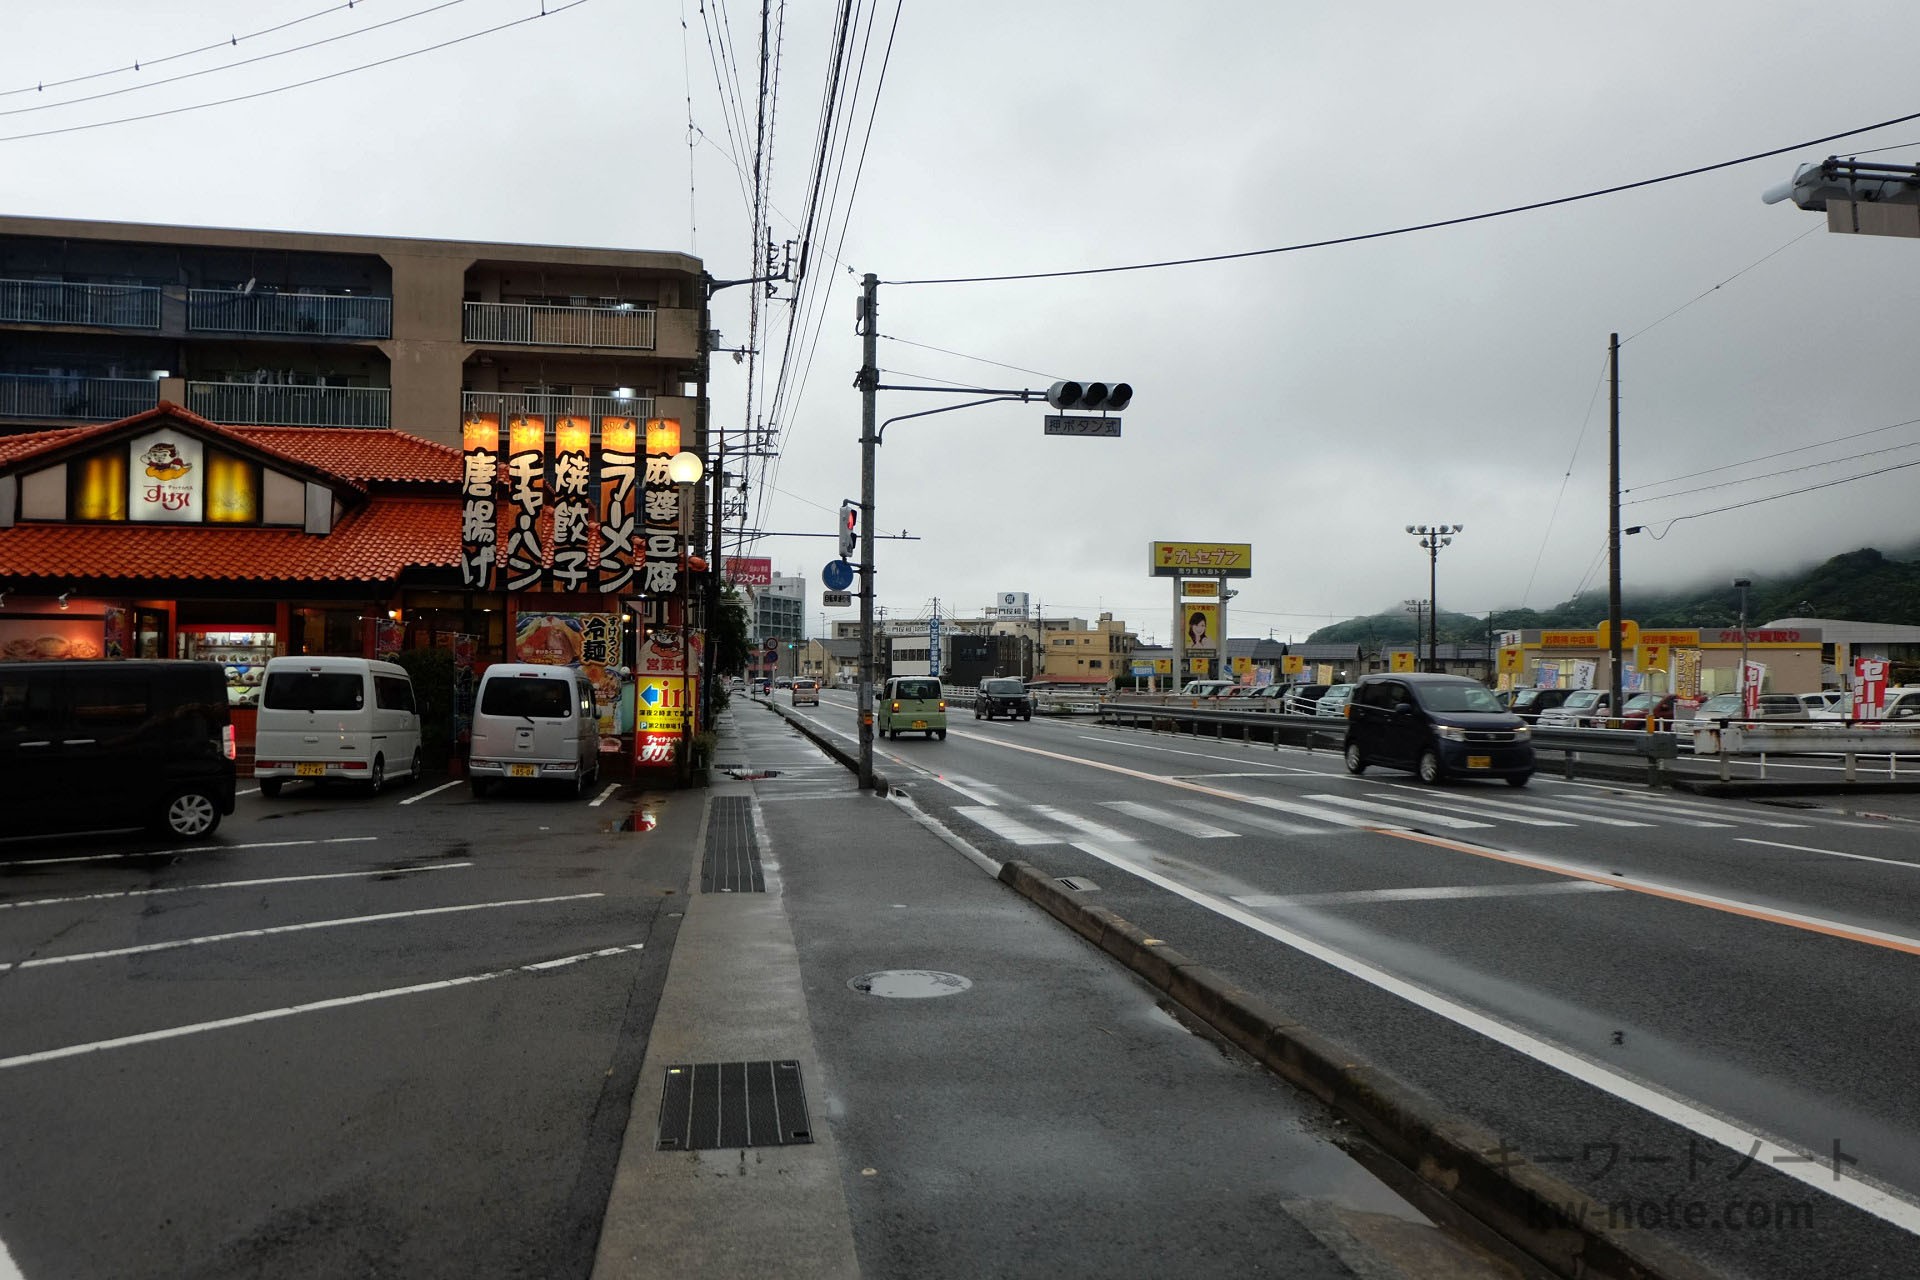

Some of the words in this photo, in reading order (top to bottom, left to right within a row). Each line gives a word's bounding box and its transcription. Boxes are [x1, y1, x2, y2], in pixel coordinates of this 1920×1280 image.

[1049, 419, 1117, 433] 押ボタン式
[462, 452, 497, 587] 唐揚げ
[507, 453, 544, 592] チャーハン
[553, 454, 590, 591] 焼餃子
[600, 452, 635, 593] ラーメン
[643, 456, 679, 593] 麻婆豆腐
[1175, 548, 1241, 566] カーセブン
[583, 616, 607, 662] 冷麺
[606, 616, 618, 662] すけろくの
[661, 680, 692, 708] in
[1860, 660, 1883, 719] セール
